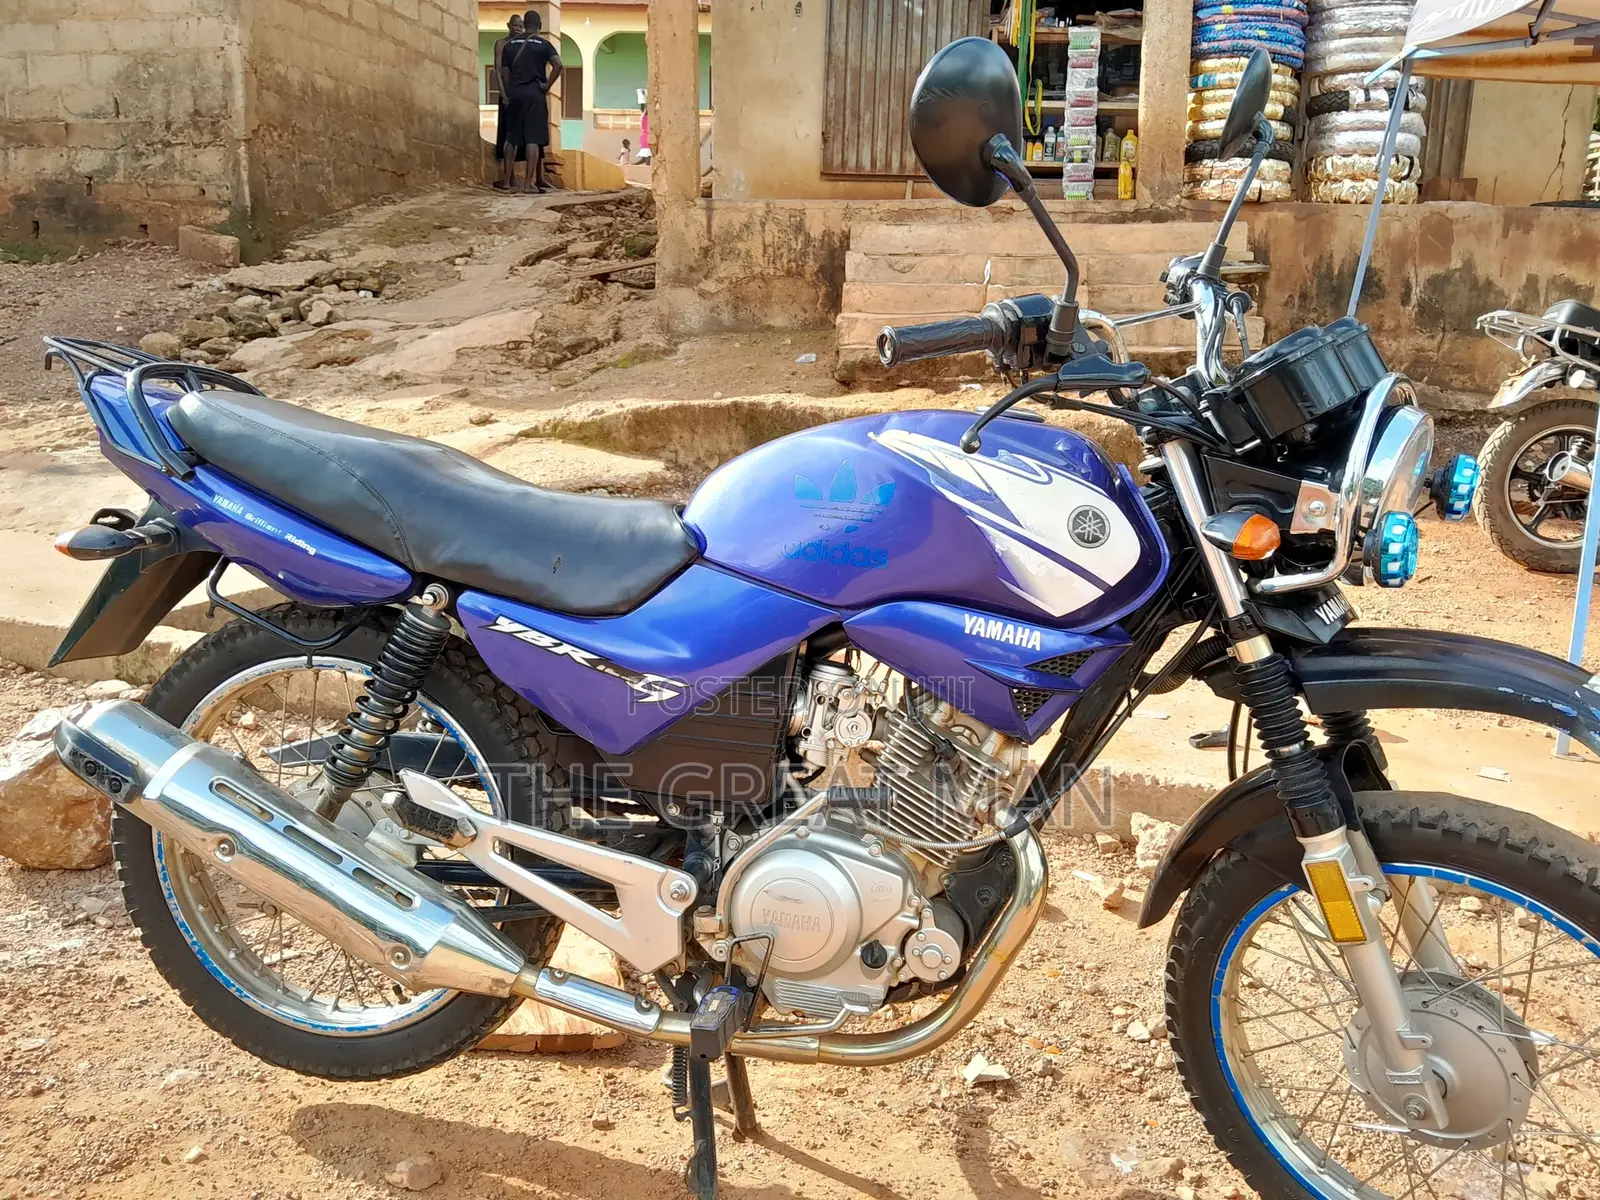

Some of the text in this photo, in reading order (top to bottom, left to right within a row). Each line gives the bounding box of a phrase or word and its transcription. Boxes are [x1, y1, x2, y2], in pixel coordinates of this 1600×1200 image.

[213, 494, 317, 556] YAMAHA Brilliant Riding
[781, 537, 889, 569] adidas
[484, 613, 604, 668] YBR
[964, 613, 1041, 652] YAMAHA
[762, 908, 821, 933] YAMAHA
